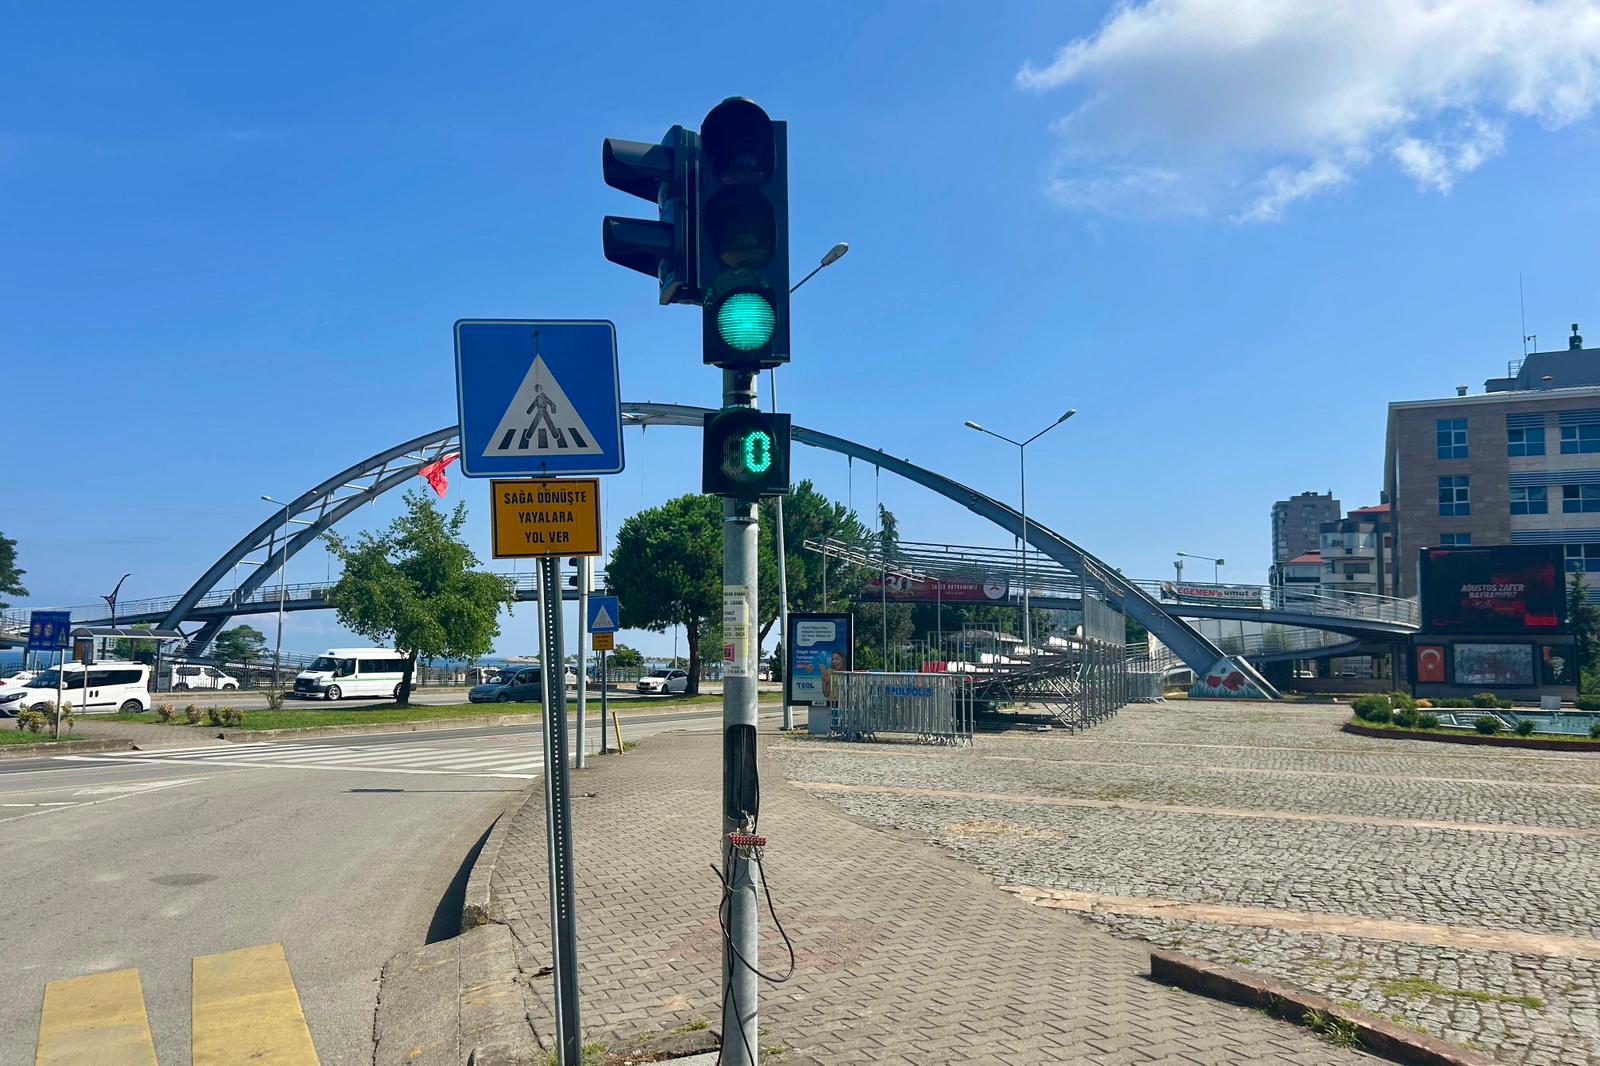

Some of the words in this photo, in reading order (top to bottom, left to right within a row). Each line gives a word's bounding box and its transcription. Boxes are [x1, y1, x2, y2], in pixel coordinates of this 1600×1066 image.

[746, 431, 771, 472] 0
[504, 490, 534, 504] SAĞA
[538, 488, 587, 506] DÖNÜŞTE
[518, 512, 574, 524] YAYALARA
[525, 532, 545, 543] YOL
[549, 531, 569, 543] VER
